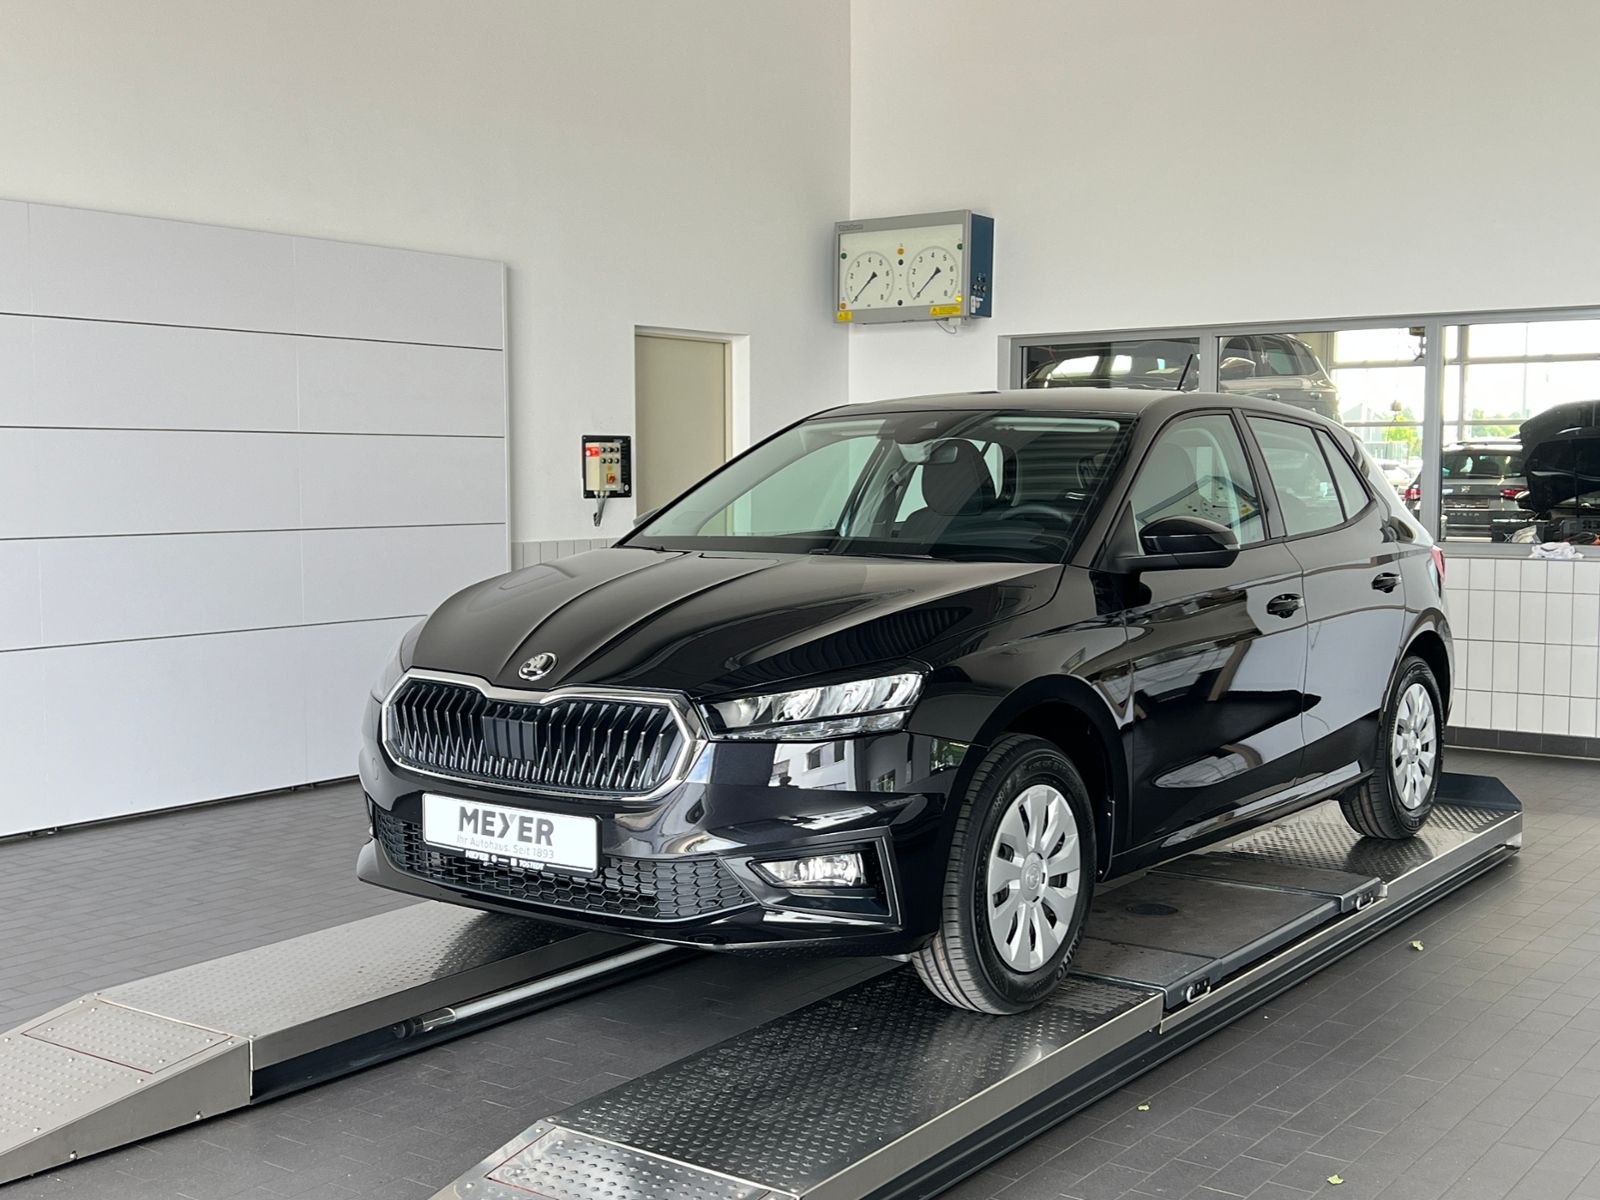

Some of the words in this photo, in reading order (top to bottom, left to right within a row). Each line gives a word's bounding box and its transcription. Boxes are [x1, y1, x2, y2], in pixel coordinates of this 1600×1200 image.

[458, 806, 554, 846] MEYER
[457, 834, 468, 844] Ihr
[470, 835, 511, 853] Autohaus.
[513, 844, 531, 856] Seit
[532, 847, 554, 859] 1893
